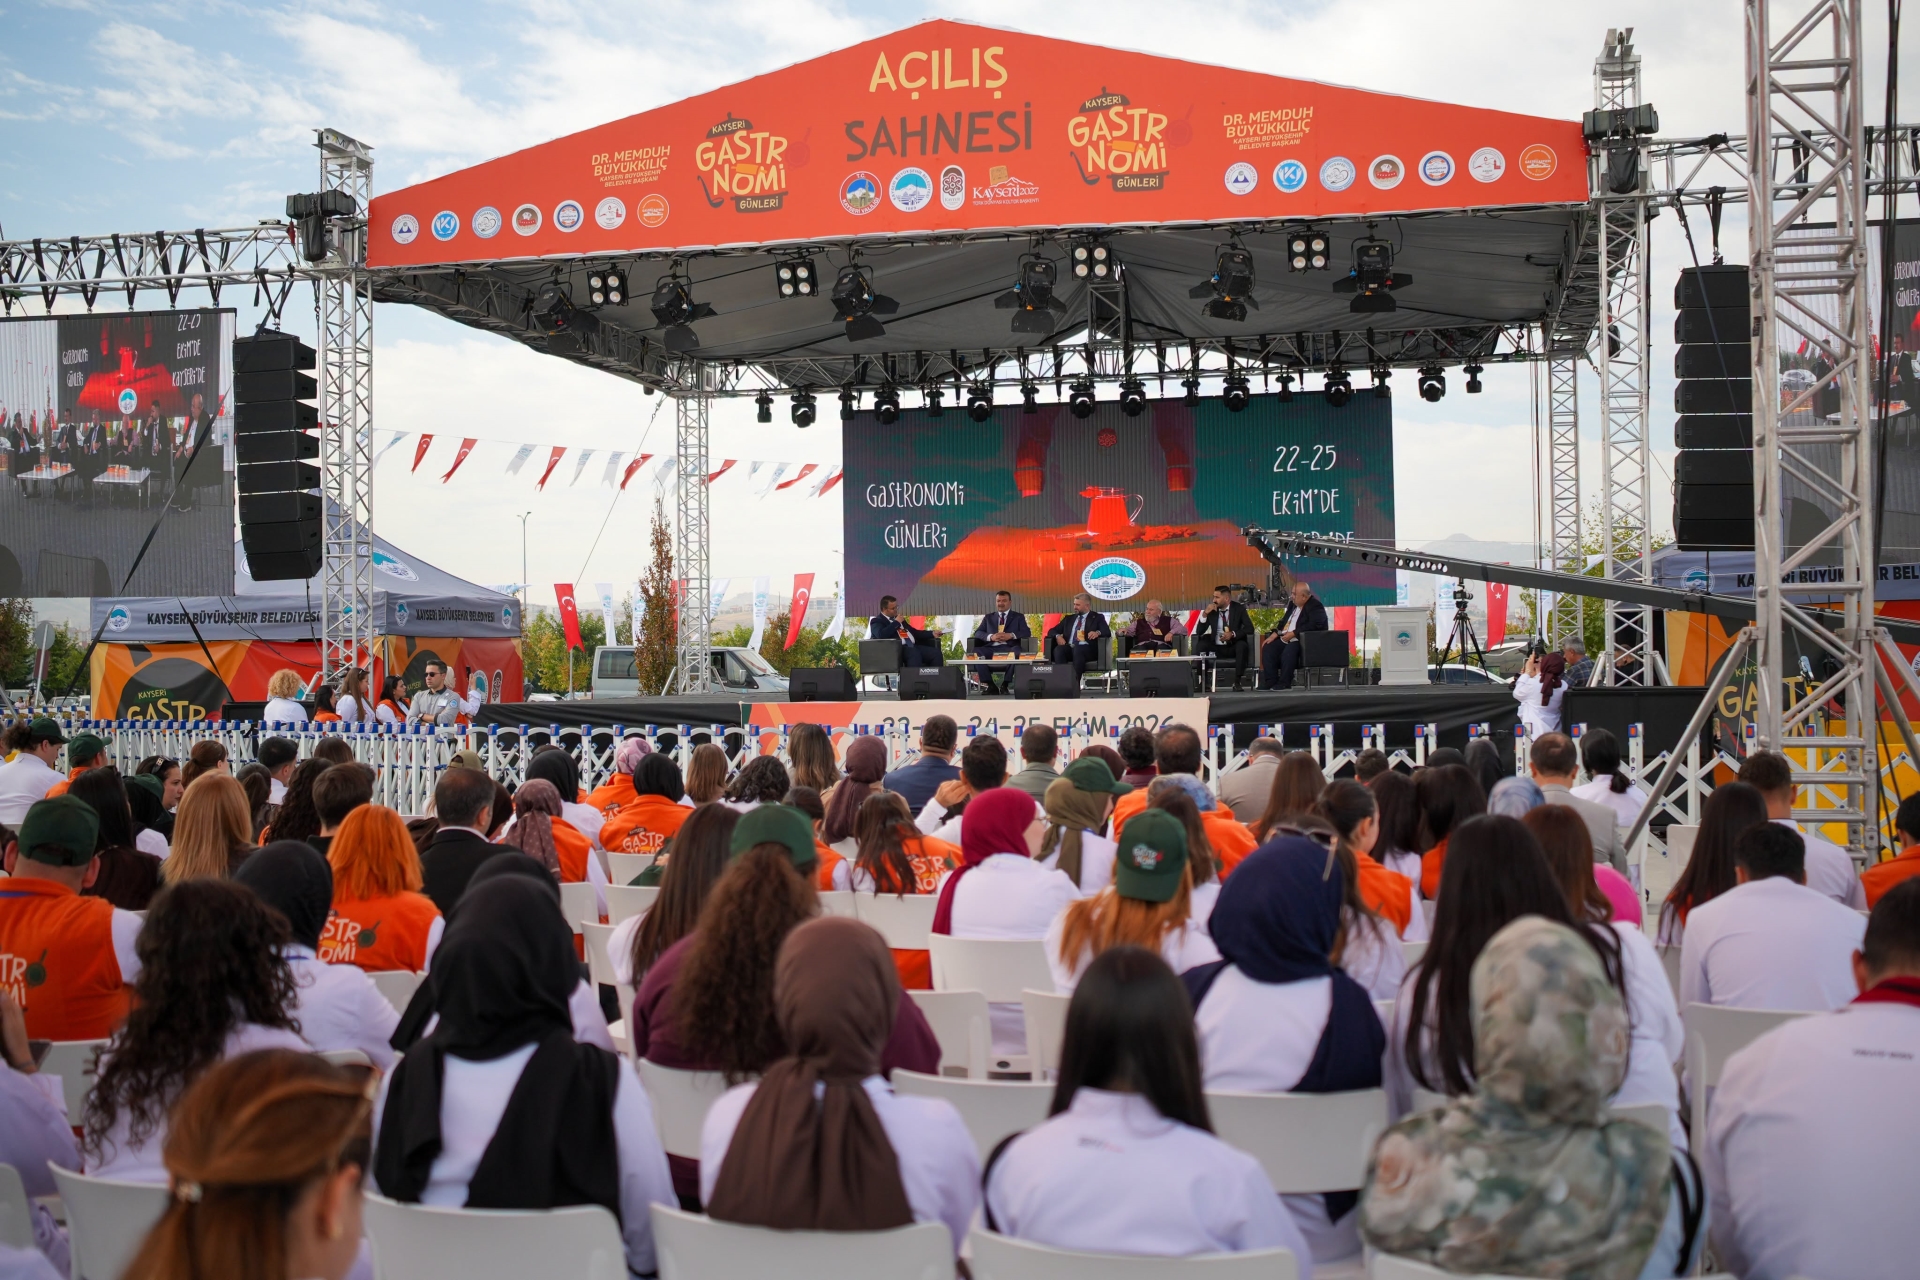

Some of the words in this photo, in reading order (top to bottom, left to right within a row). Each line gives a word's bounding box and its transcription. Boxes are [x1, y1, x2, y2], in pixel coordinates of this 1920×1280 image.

[869, 46, 1008, 100] AÇILIŞ
[1085, 96, 1121, 109] KAYSERİ
[1223, 114, 1246, 126] DR.
[1249, 106, 1313, 124] MEMDUH
[712, 120, 746, 134] KAYSERİ
[844, 102, 1032, 162] SAHNESİ
[1068, 106, 1168, 147] GASTR
[1226, 119, 1311, 138] BÜYÜKKILIÇ
[592, 153, 611, 165] DR.
[614, 145, 671, 162] MEMDUH
[695, 130, 788, 171] GASTR
[594, 157, 668, 176] BÜYÜKKILIÇ
[1117, 176, 1159, 188] GÜNLERİ
[740, 197, 779, 209] GÜNLERİ
[1273, 444, 1337, 472] 22-25
[138, 688, 167, 699] KAYSERİ
